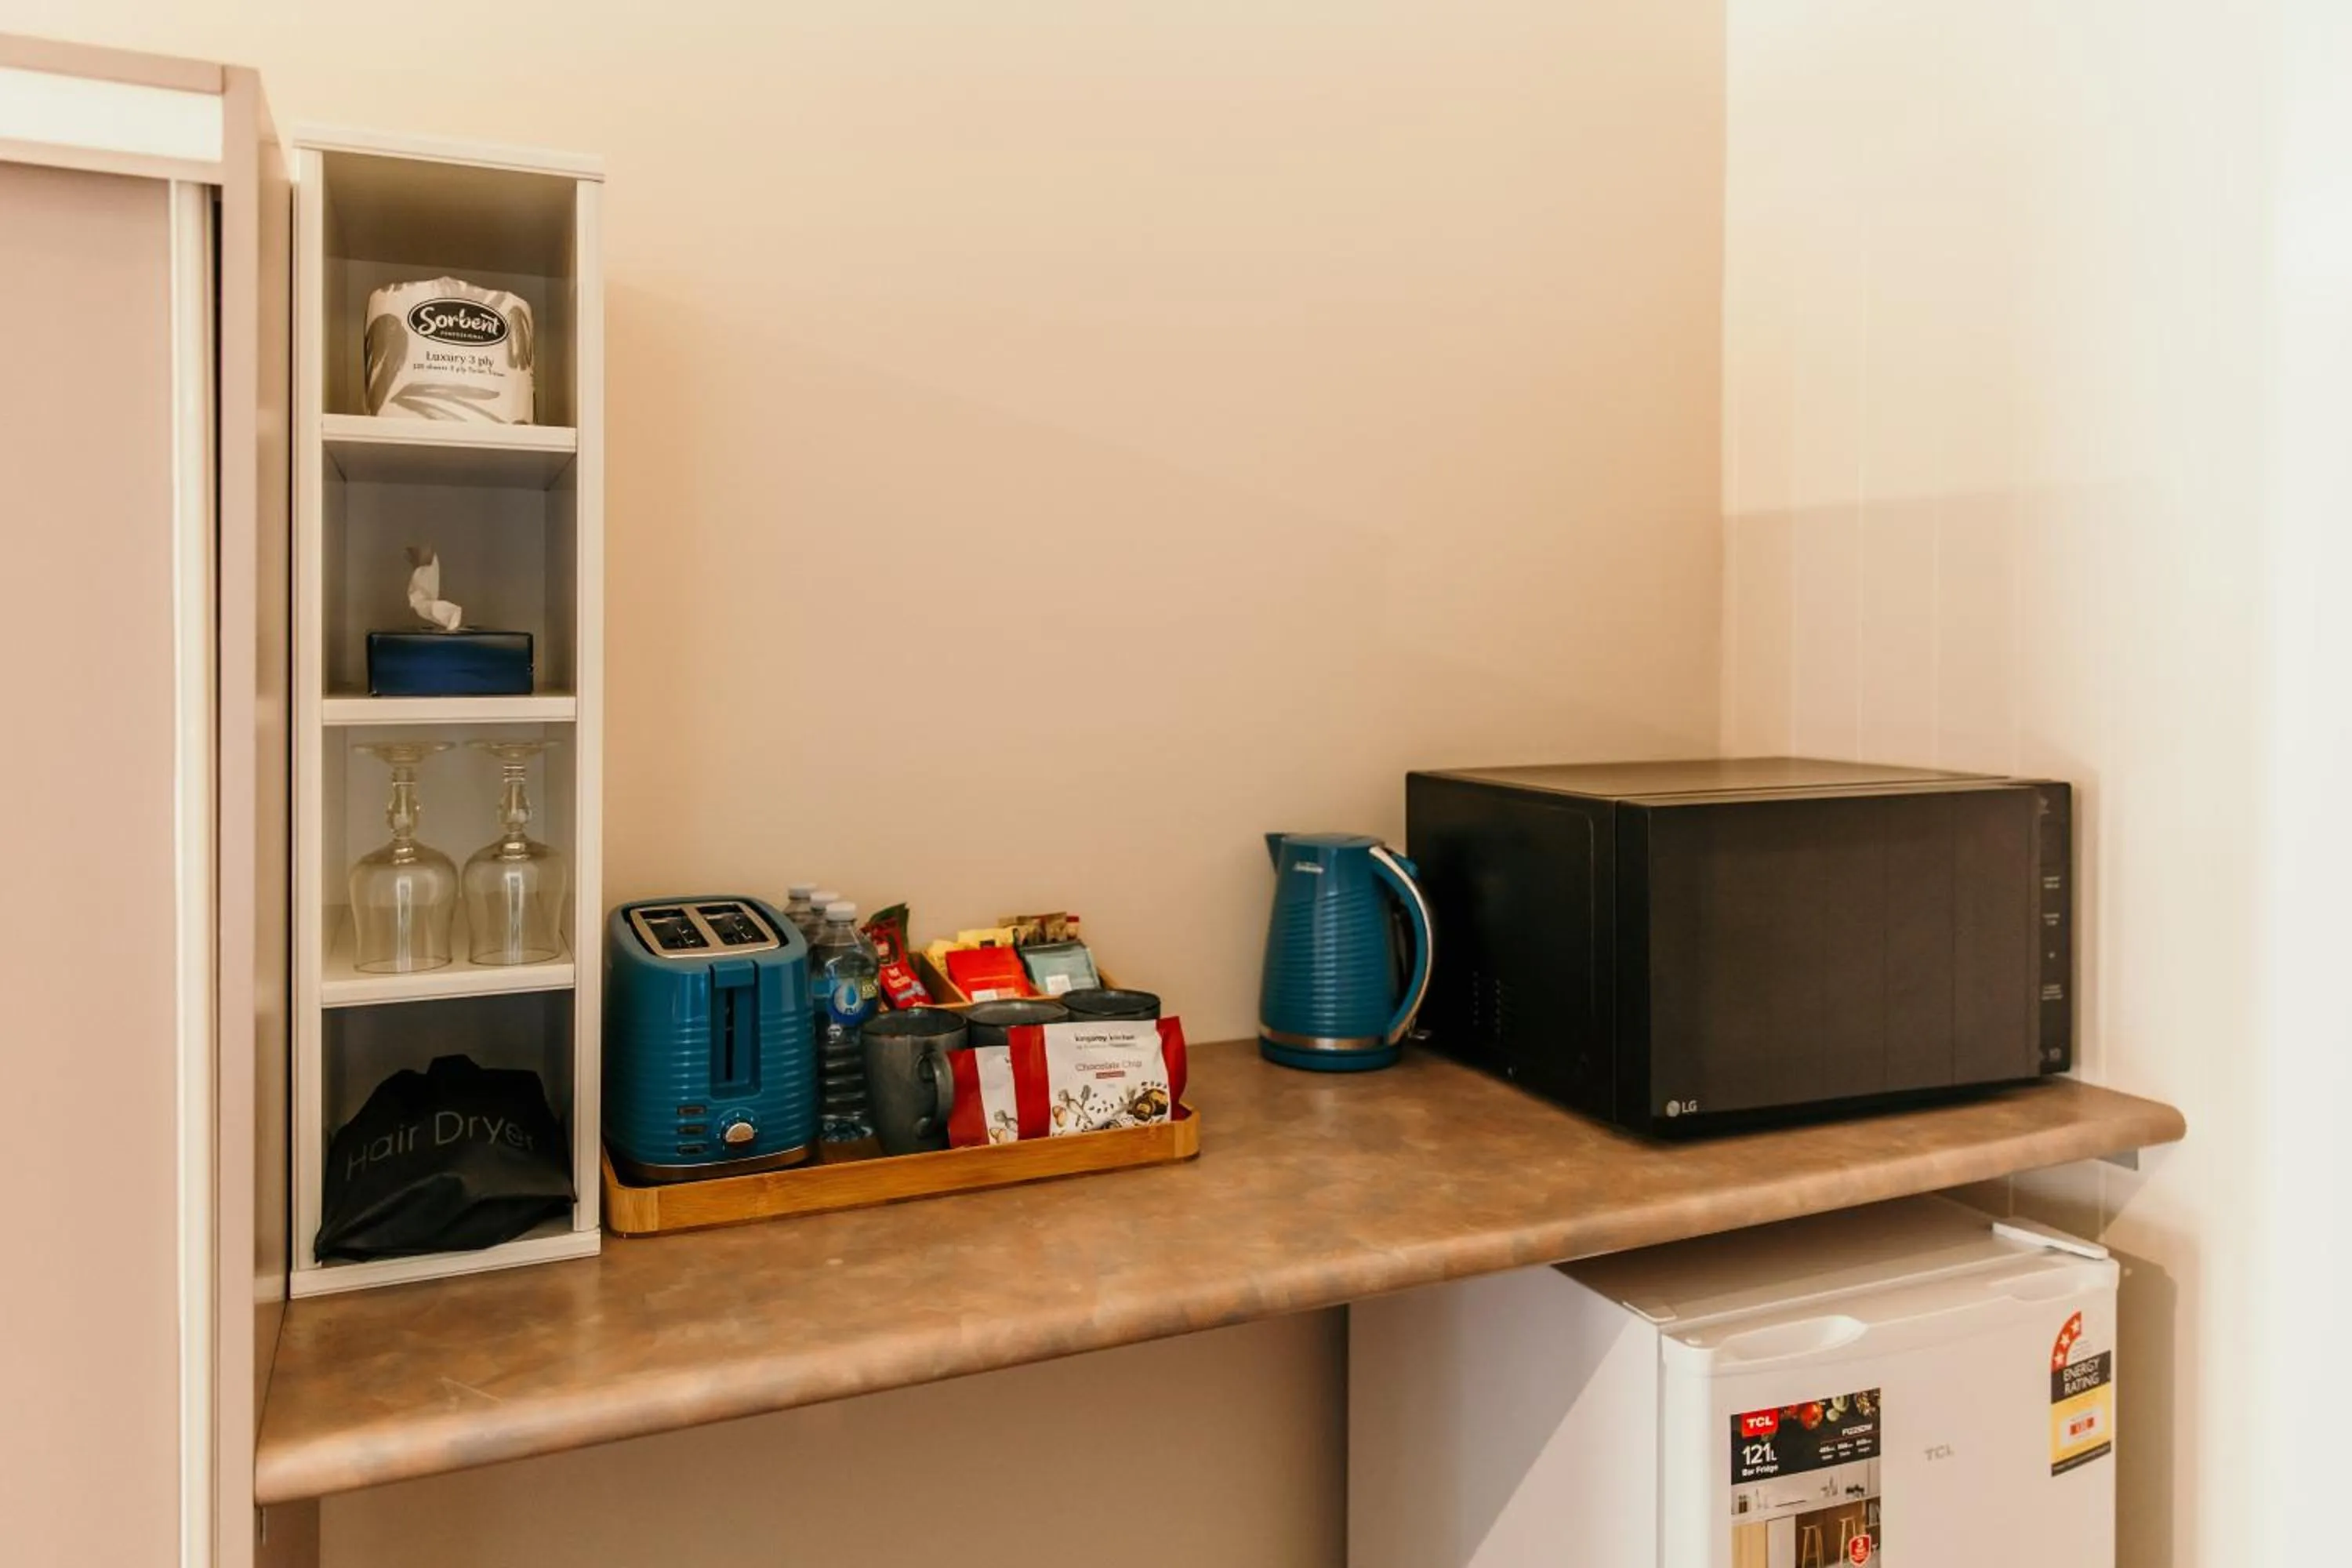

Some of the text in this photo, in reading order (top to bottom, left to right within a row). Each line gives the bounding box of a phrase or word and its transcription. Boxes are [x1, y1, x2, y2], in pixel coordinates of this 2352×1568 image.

[418, 307, 500, 336] Sorbent
[426, 350, 495, 368] Luxury 3 ply
[1075, 1059, 1143, 1072] Chocolate Chip
[1682, 1100, 1697, 1113] LG
[346, 1110, 534, 1181] Hair Dryer
[2063, 1357, 2100, 1381] ENERGY
[2064, 1371, 2100, 1396] RATING
[1746, 1415, 1774, 1429] TCL
[1924, 1443, 1955, 1461] TCL
[1755, 1464, 1780, 1475] Fridge
